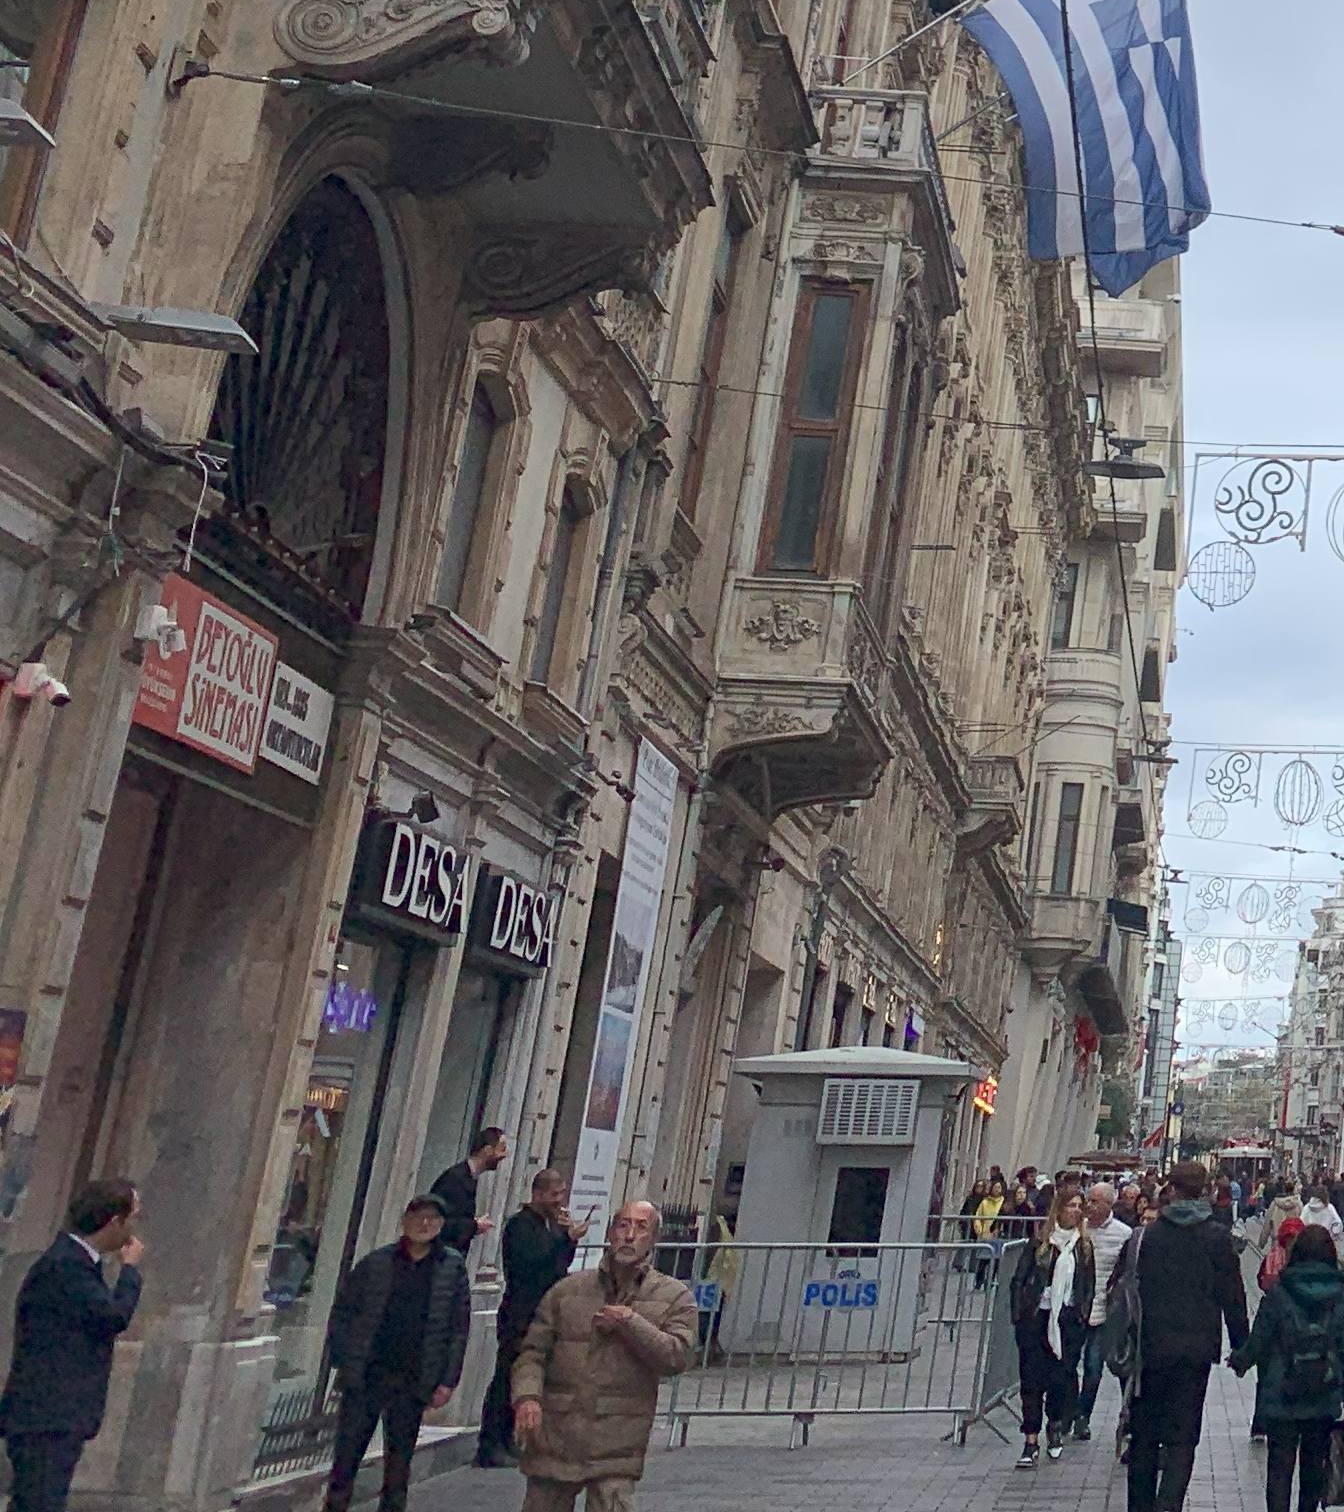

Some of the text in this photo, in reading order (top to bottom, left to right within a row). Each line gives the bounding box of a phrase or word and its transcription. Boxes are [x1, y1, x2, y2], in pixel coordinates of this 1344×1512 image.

[195, 614, 269, 699] BEYOĞLU
[184, 673, 259, 754] SİNEMASI
[382, 822, 470, 936] DESA
[490, 876, 560, 968] DESA
